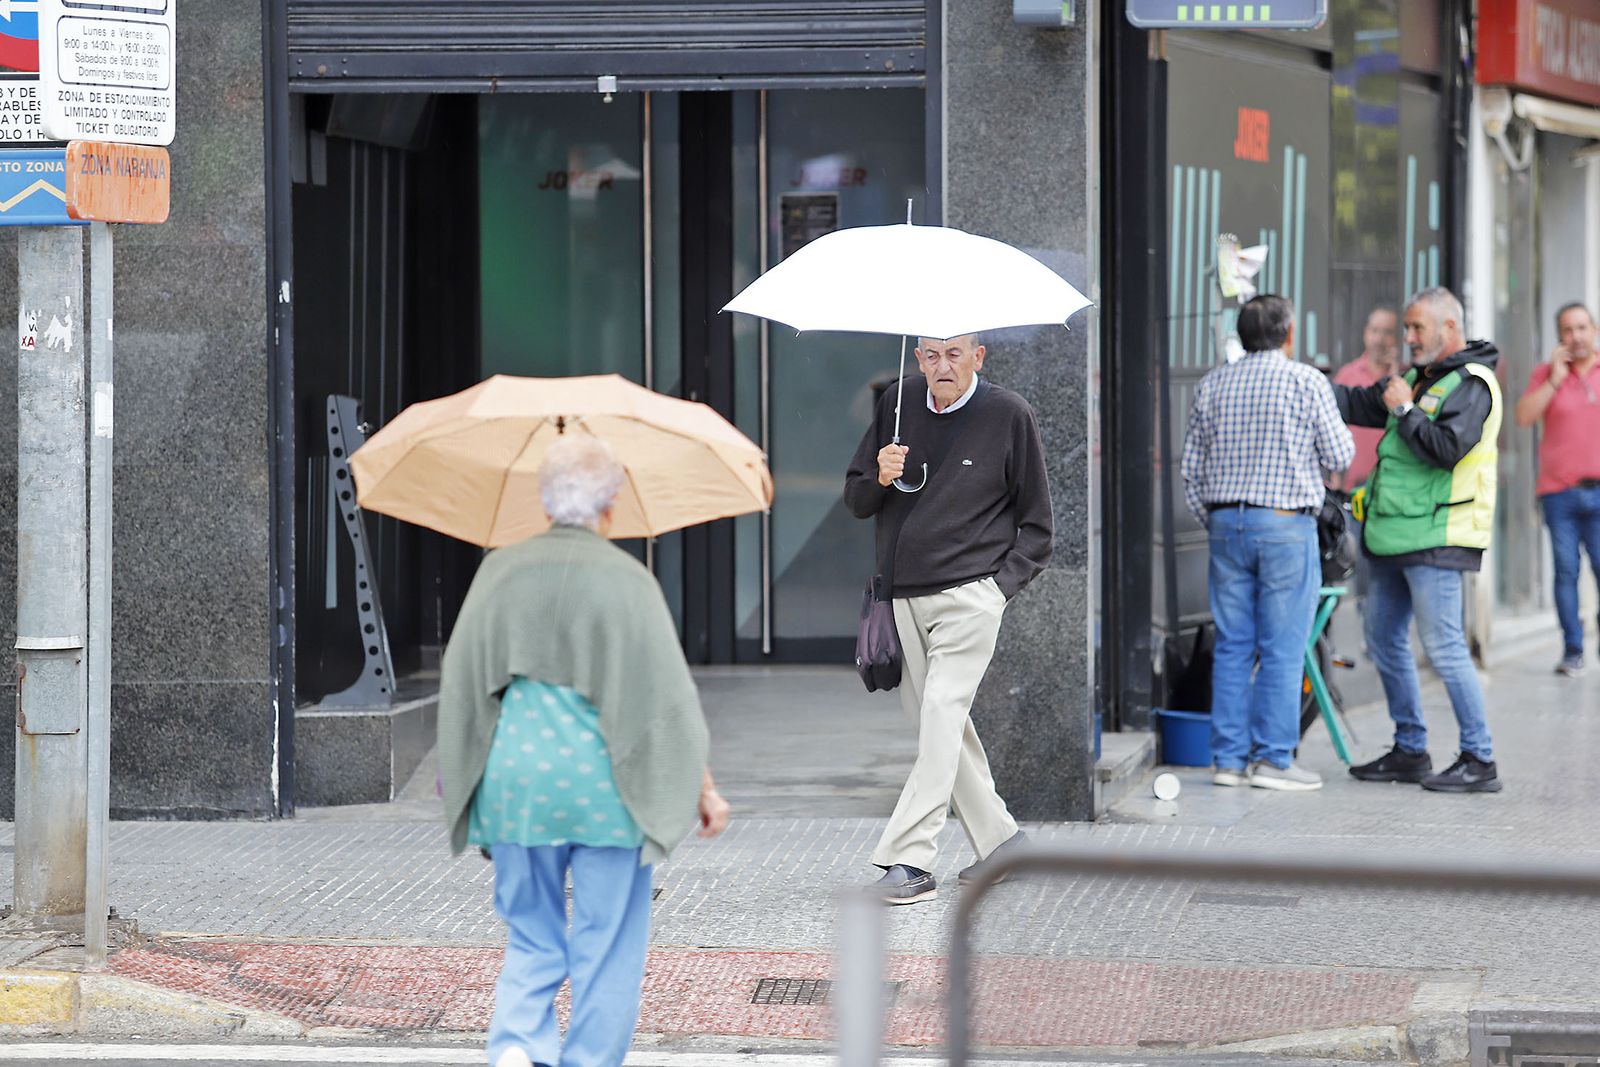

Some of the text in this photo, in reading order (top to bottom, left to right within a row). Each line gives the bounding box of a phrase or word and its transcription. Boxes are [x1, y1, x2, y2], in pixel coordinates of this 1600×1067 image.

[83, 25, 107, 37] Lunes
[111, 29, 115, 37] a
[119, 27, 143, 40] Viernes
[64, 38, 80, 49] 9:00
[83, 41, 88, 50] a
[110, 56, 118, 65] de
[121, 55, 133, 66] 9:00
[79, 66, 115, 80] Domingos
[123, 69, 145, 81] festivos
[7, 87, 15, 98] Y
[20, 87, 36, 98] DE
[58, 90, 171, 108] ZONA DE ESTACIONAMIENTO
[12, 114, 20, 125] Y
[24, 113, 40, 125] DE
[64, 106, 167, 123] LIMITADO Y CONTROLADO
[26, 129, 31, 139] 1
[76, 122, 159, 137] TICKET OBLIGATORIO
[0, 161, 65, 173] TO ZONA
[81, 153, 166, 179] ZONA NARANJA
